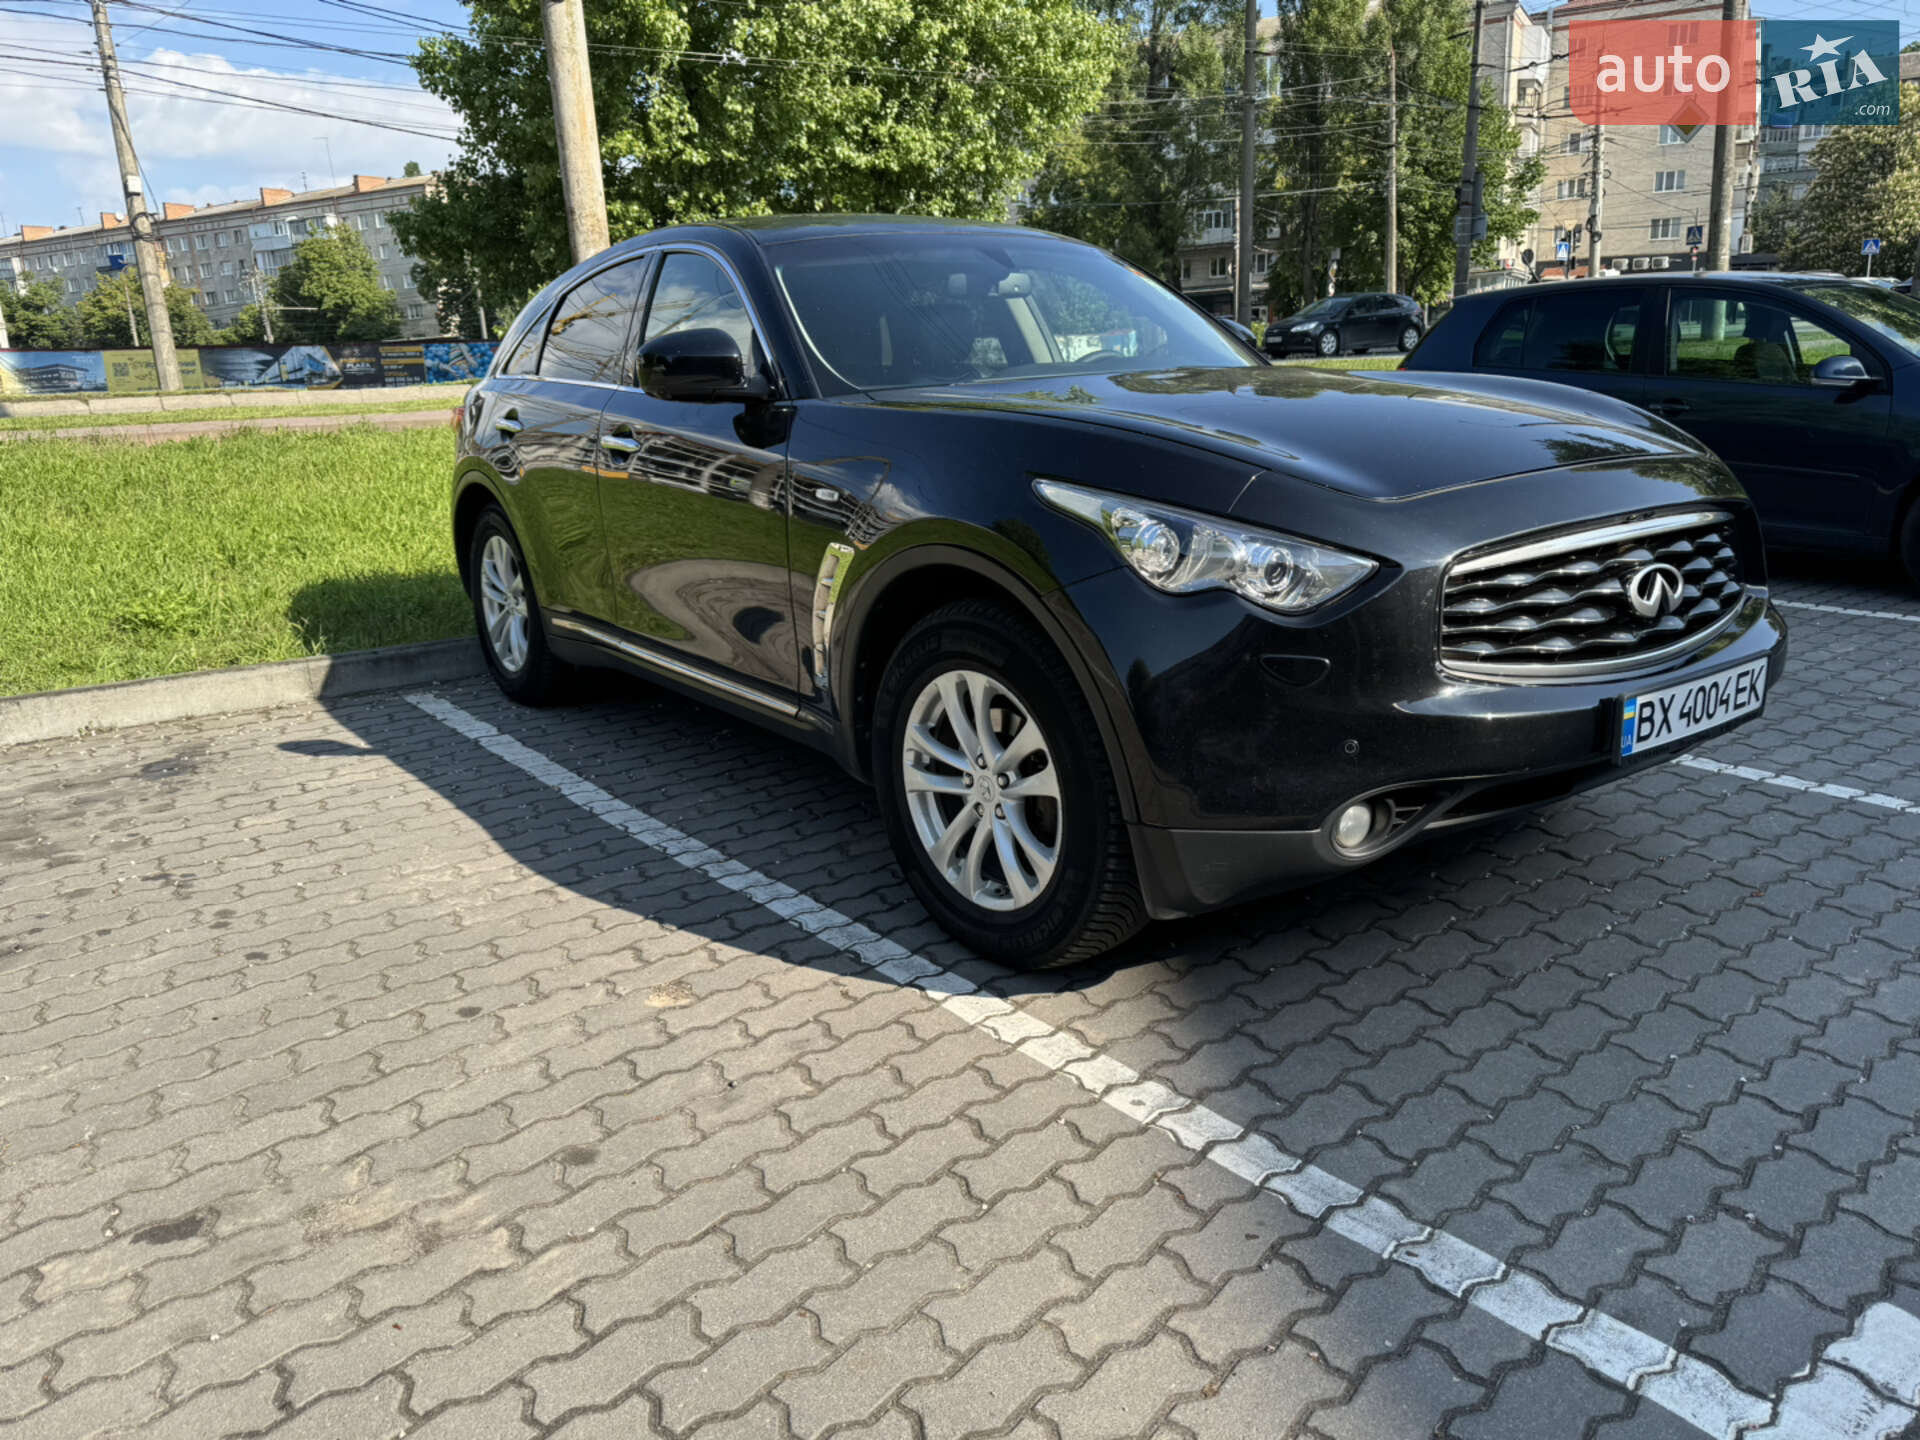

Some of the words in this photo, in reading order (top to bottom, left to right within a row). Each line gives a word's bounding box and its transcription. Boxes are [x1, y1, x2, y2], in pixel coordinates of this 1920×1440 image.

[1635, 693, 1676, 744] BX
[1679, 675, 1732, 728] 4004
[1733, 664, 1765, 711] EK
